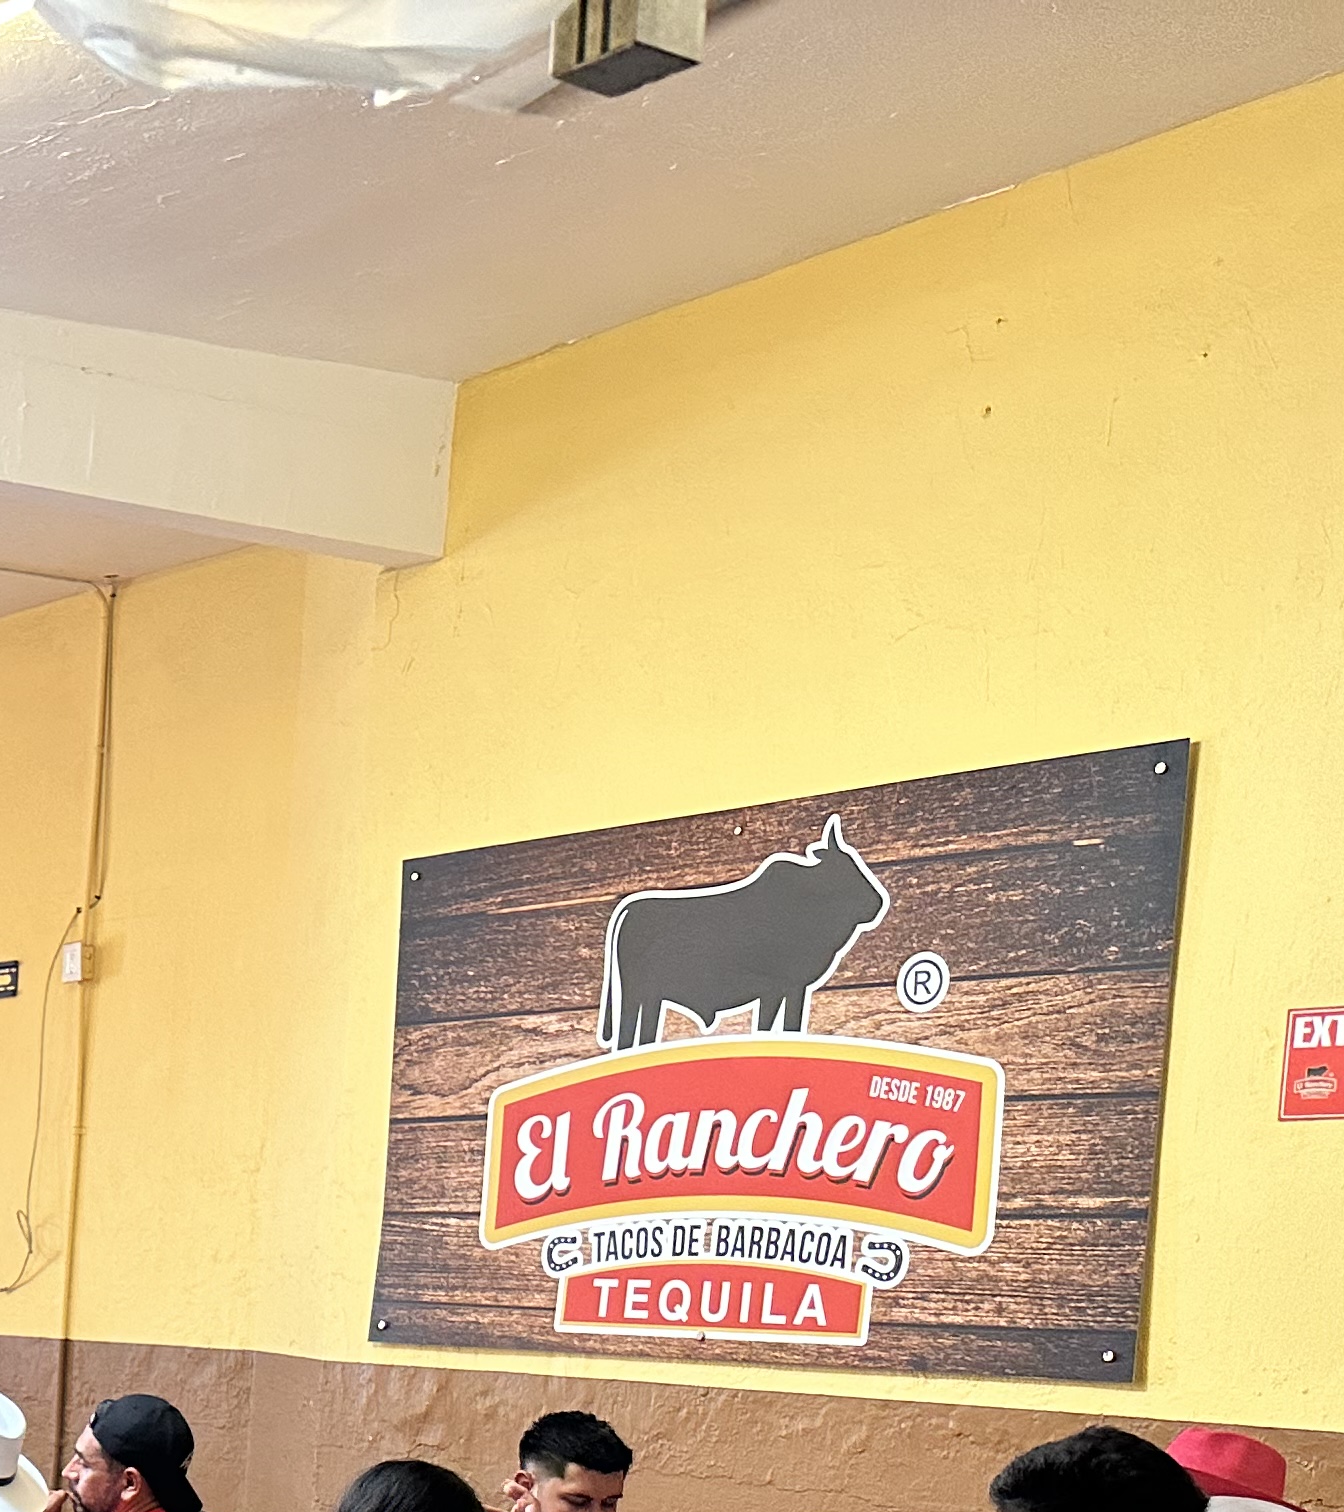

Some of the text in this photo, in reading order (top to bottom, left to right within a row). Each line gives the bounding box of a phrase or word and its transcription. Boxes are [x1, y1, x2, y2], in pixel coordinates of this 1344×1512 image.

[869, 1075, 966, 1113] DESDE 1987
[513, 1088, 955, 1203] El Ranchero
[593, 1224, 848, 1269] TACOS DE BARBACOA
[593, 1278, 827, 1327] TEQUILA
